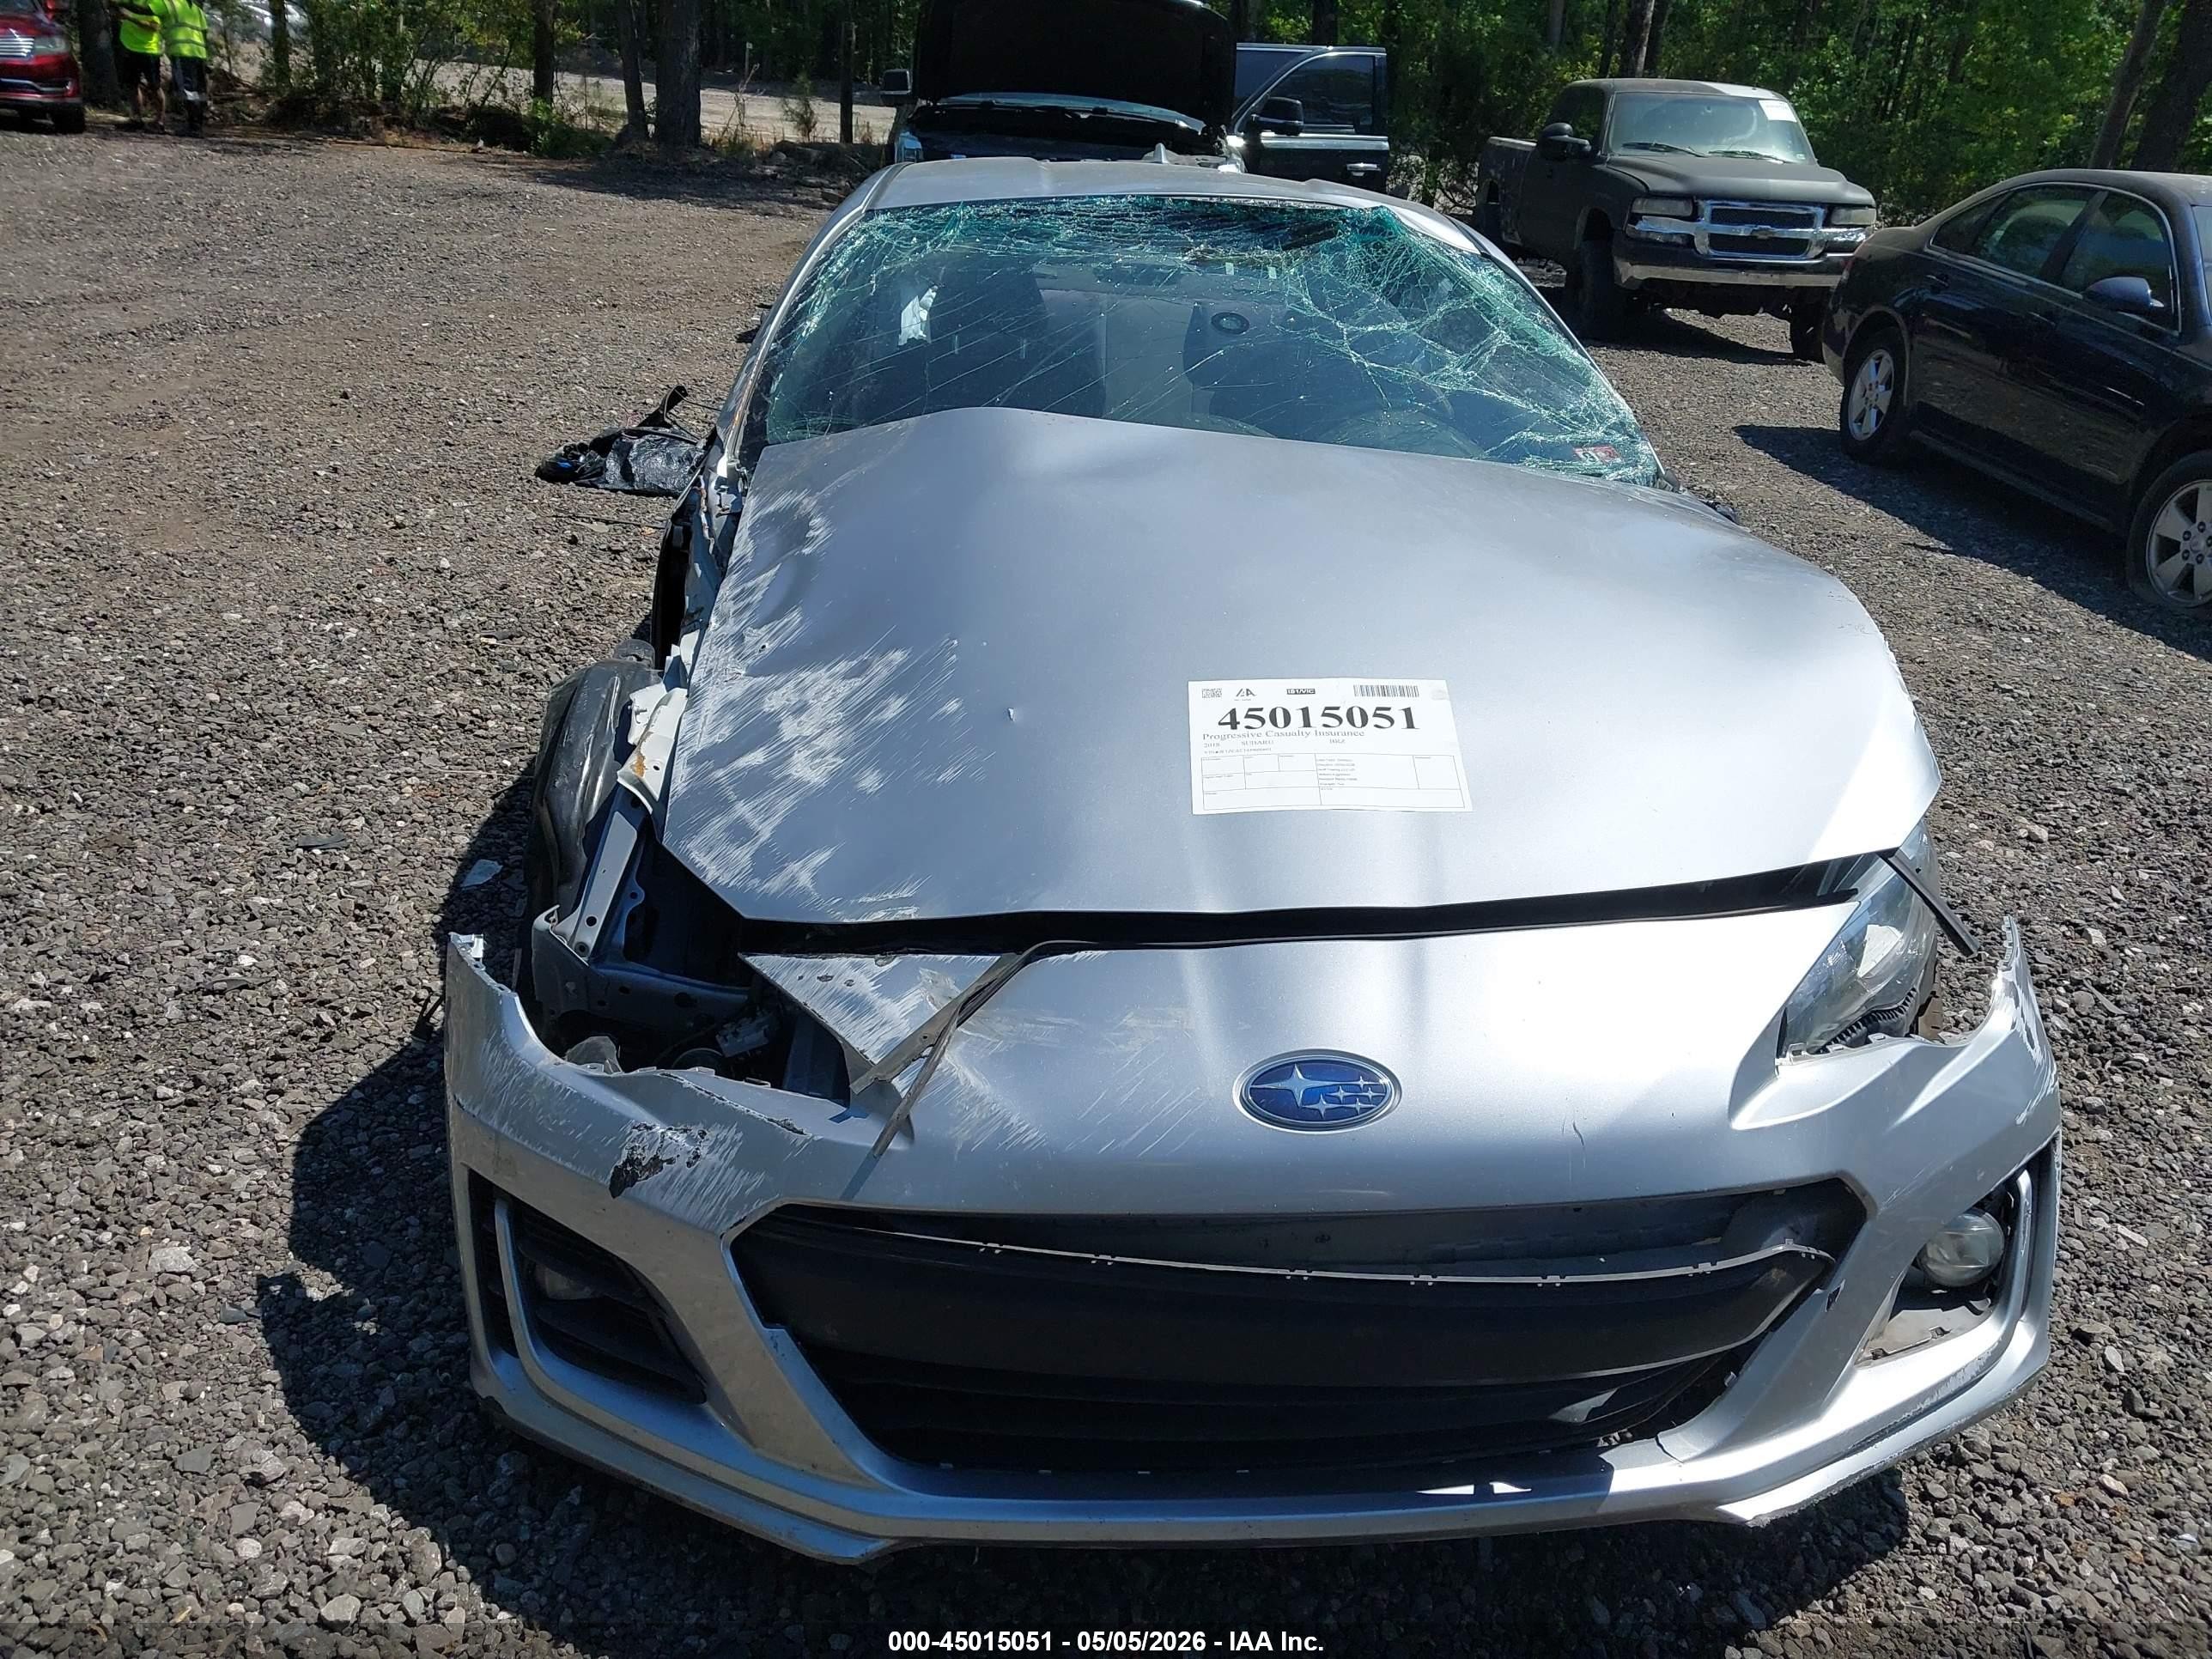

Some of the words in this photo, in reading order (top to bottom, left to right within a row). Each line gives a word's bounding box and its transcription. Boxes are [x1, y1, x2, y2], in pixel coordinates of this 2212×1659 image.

[1218, 706, 1420, 730] 45015051
[1202, 731, 1262, 741] Progressive
[1266, 730, 1310, 738] Casualty
